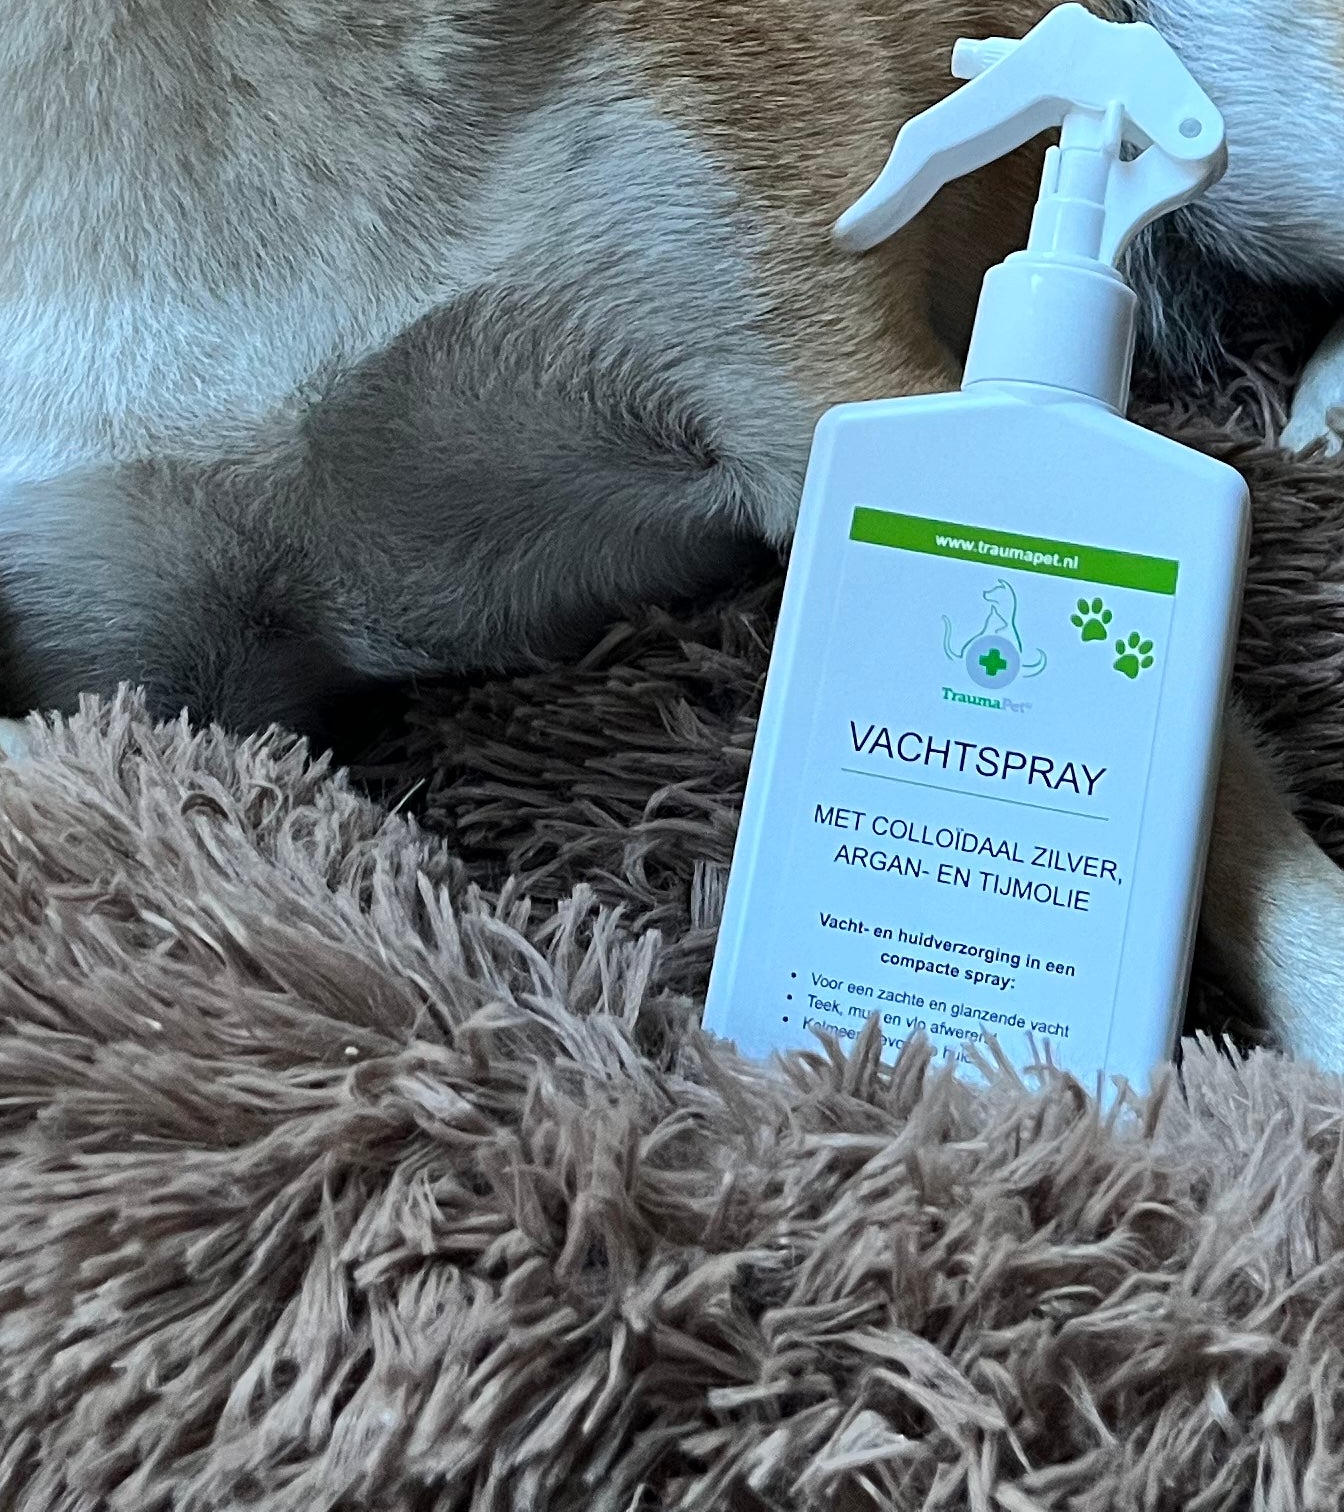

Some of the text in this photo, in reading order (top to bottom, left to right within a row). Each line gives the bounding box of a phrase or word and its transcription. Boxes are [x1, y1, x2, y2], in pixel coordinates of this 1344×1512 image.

[935, 534, 1080, 571] www.traumapet.nl
[850, 721, 1107, 797] VACHTSPRAY
[814, 804, 1122, 885] MET COLLOÏDAAL ZILVER,
[834, 844, 1091, 911] ARGAN- EN TIJMOLIE
[820, 912, 1076, 977] Vacht- en huidverzorging in een
[880, 952, 1015, 990] compacte spray:
[808, 994, 843, 1016] Teek,
[883, 1013, 901, 1026] en
[906, 1016, 926, 1030] vlo
[930, 1021, 998, 1046] afwere
[811, 972, 1069, 1038] Voor een zachte en glanzende vacht
